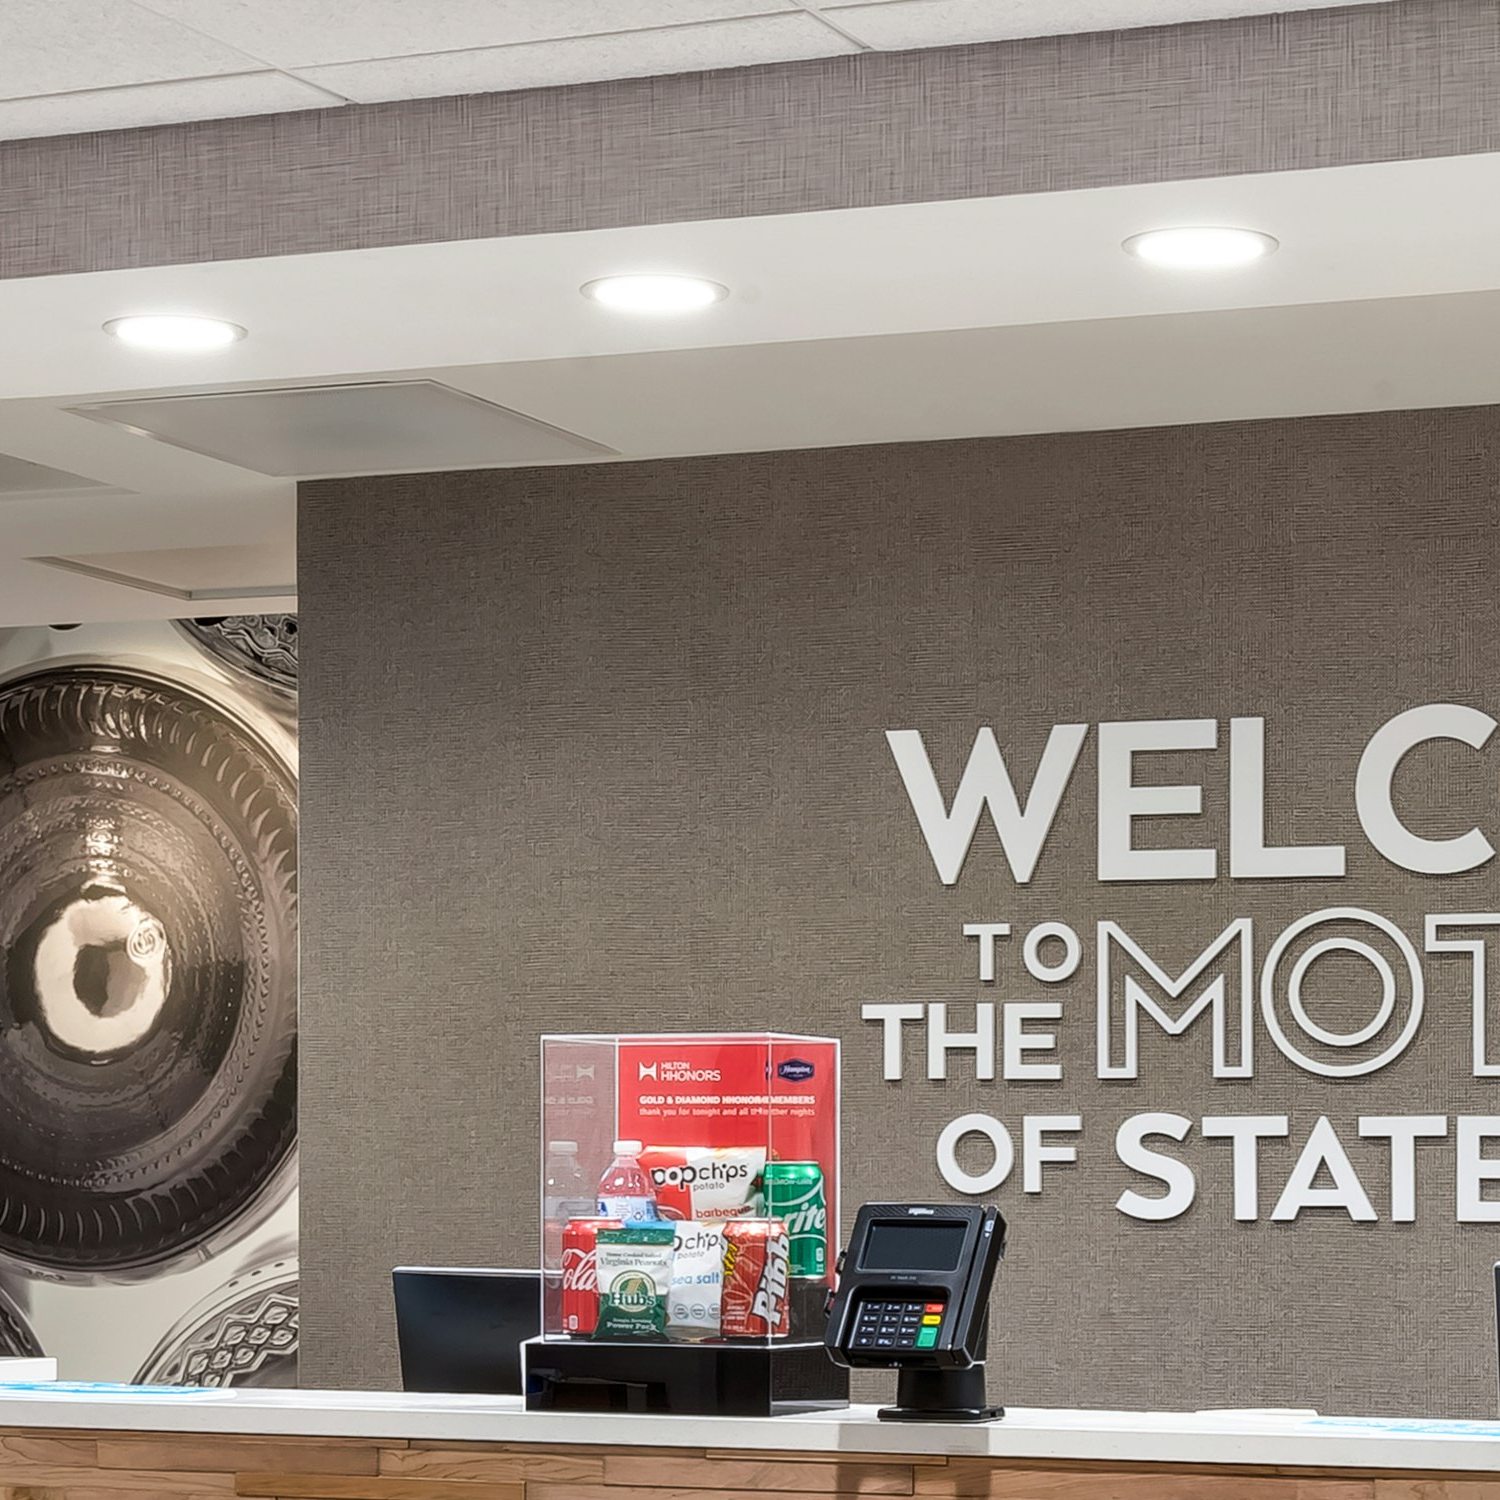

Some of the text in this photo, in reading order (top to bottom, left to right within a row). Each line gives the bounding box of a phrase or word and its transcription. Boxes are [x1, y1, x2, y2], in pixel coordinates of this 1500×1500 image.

[962, 920, 1083, 984] TO
[861, 1002, 1064, 1082] THE
[661, 1061, 690, 1070] HILTON
[661, 1070, 721, 1082] HHONORS
[639, 1096, 665, 1105] GOLD
[666, 1096, 673, 1105] &
[675, 1096, 721, 1105] DIAMOND
[639, 1108, 661, 1116] thank
[662, 1110, 677, 1118] you
[678, 1108, 690, 1116] for
[692, 1108, 721, 1118] tonight
[722, 1108, 737, 1116] and
[739, 1108, 749, 1116] all
[935, 1112, 1082, 1195] OF
[651, 1162, 750, 1190] popchips
[692, 1181, 725, 1192] potato
[783, 1202, 827, 1236] rite
[600, 1257, 667, 1267] Virginia Peanuts
[671, 1271, 720, 1286] sea salt
[752, 1232, 790, 1327] Pibb
[610, 1291, 655, 1307] Hubs
[634, 1322, 657, 1331] Pack
